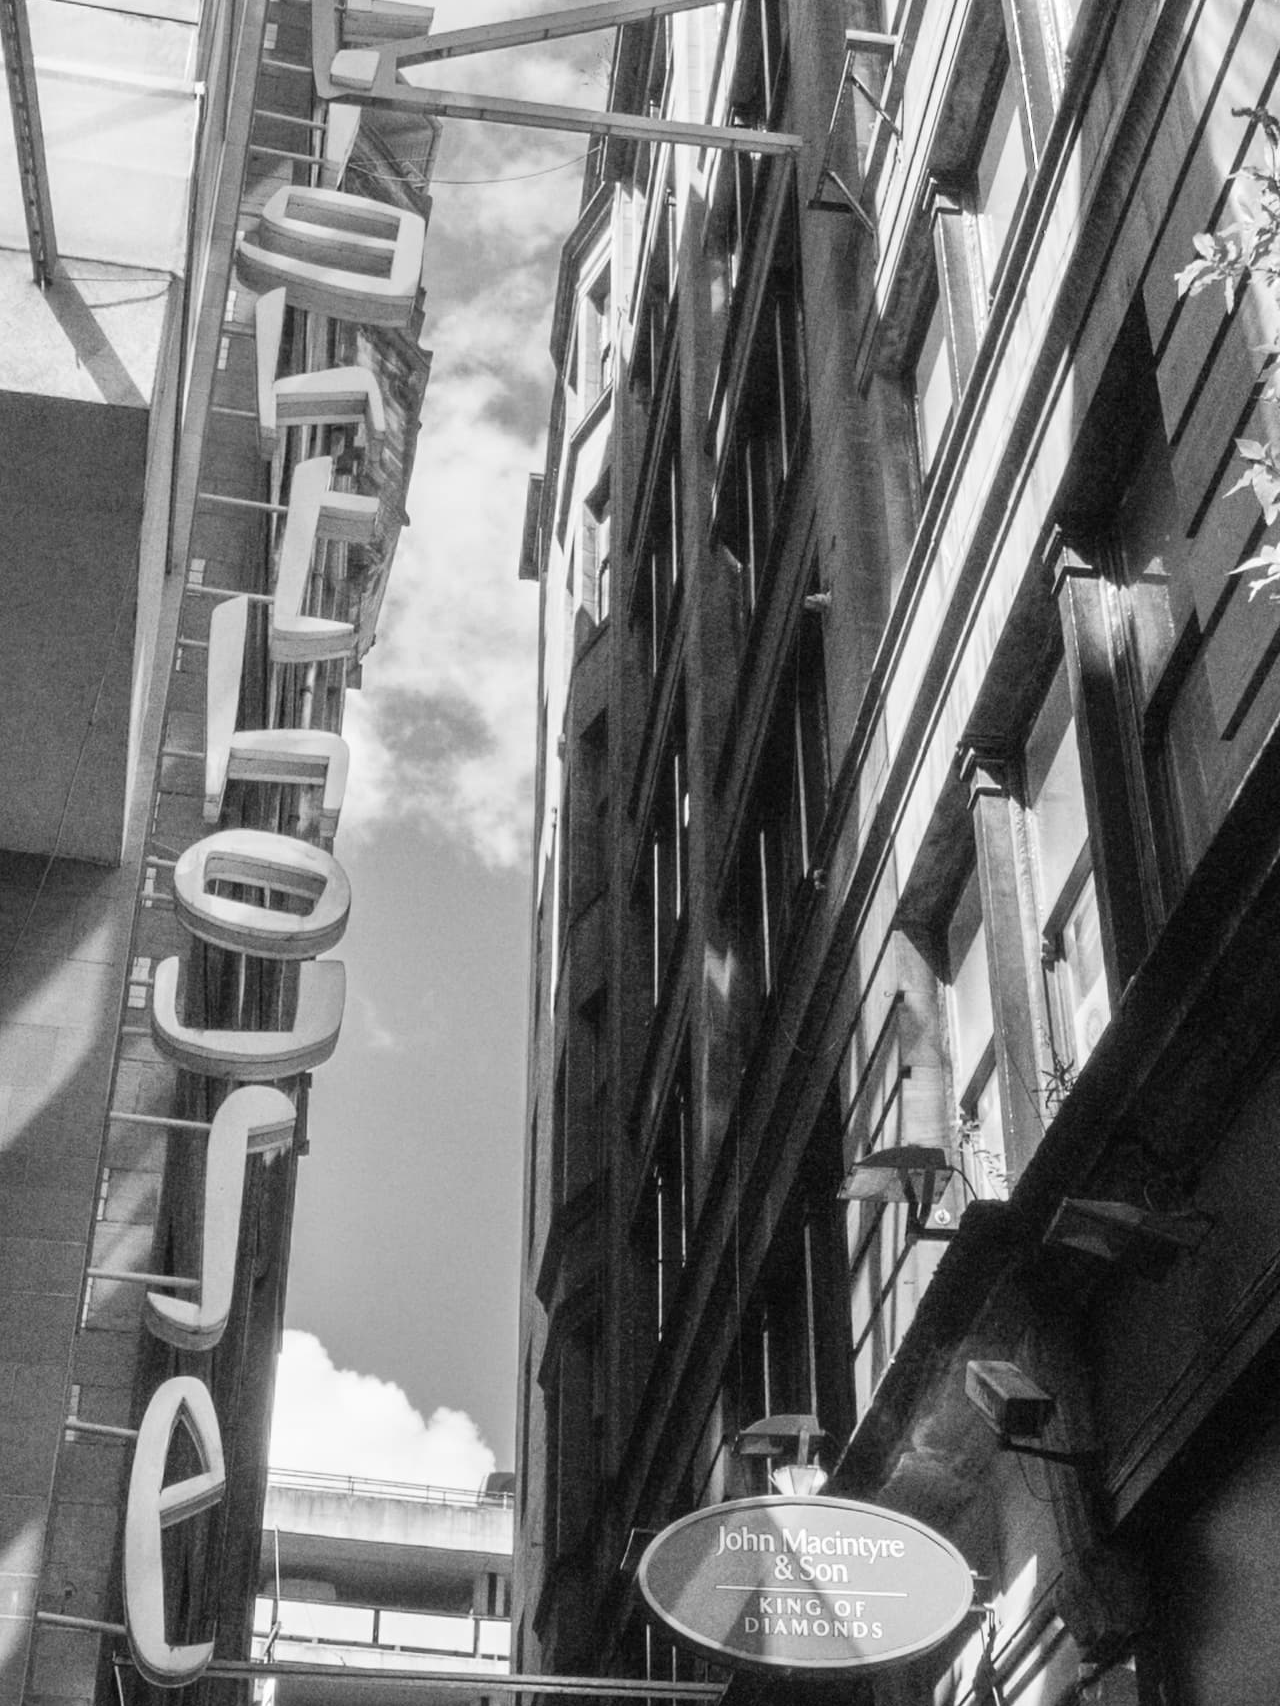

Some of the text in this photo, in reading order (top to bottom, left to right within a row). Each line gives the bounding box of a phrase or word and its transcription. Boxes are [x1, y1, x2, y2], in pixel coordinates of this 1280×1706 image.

[716, 1526, 905, 1563] John Macintyre
[775, 1555, 849, 1583] & Son
[759, 1597, 866, 1618] KING OF
[745, 1617, 884, 1639] DIAMONDS
